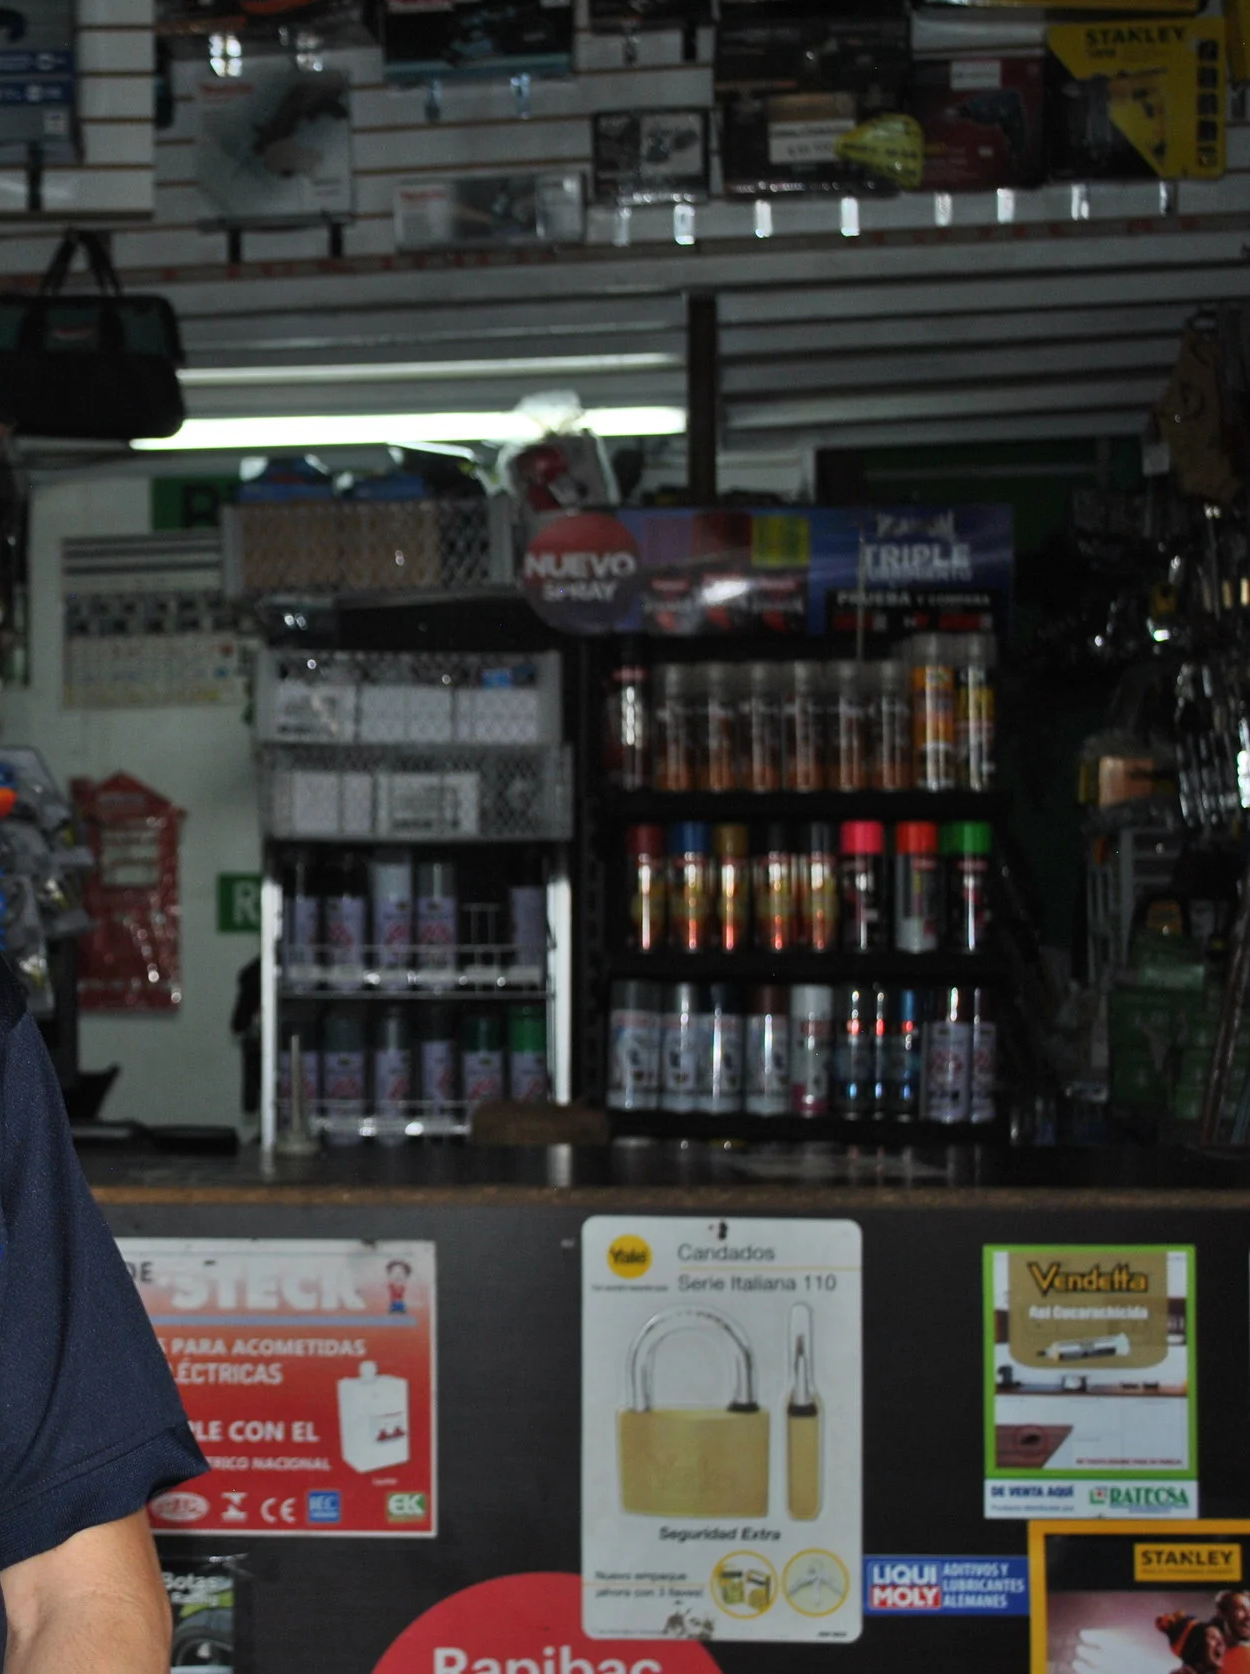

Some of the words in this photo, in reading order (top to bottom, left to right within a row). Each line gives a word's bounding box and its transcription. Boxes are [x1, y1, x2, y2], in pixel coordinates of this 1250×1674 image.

[1086, 27, 1185, 46] STANLEY
[524, 552, 636, 577] NUEVO
[542, 579, 616, 602] SPRAY
[609, 1245, 648, 1266] Yale
[677, 1243, 776, 1262] Candados
[172, 1258, 366, 1311] STECK
[677, 1273, 726, 1292] Serie
[730, 1273, 797, 1292] Italiana
[804, 1273, 838, 1292] 110
[1027, 1262, 1149, 1297] Vendetta
[172, 1338, 228, 1356] PARA
[231, 1338, 367, 1357] ACOMETIDAS
[228, 1420, 285, 1443] CON
[291, 1420, 320, 1442] EL
[251, 1456, 332, 1472] NACIONAL
[991, 1486, 1005, 1498] DE
[1009, 1486, 1044, 1498] VENTA
[1109, 1486, 1189, 1506] RATECSA
[658, 1527, 737, 1543] Seguridad
[740, 1526, 782, 1542] Extra
[1140, 1550, 1234, 1566] STANLEY
[873, 1563, 938, 1586] LIQUI
[943, 1562, 999, 1578] ADITIVOS
[1001, 1563, 1010, 1578] Y
[943, 1577, 1025, 1593] LUBRICANTES
[872, 1586, 940, 1608] MOLY
[943, 1593, 1008, 1609] ALEMANES
